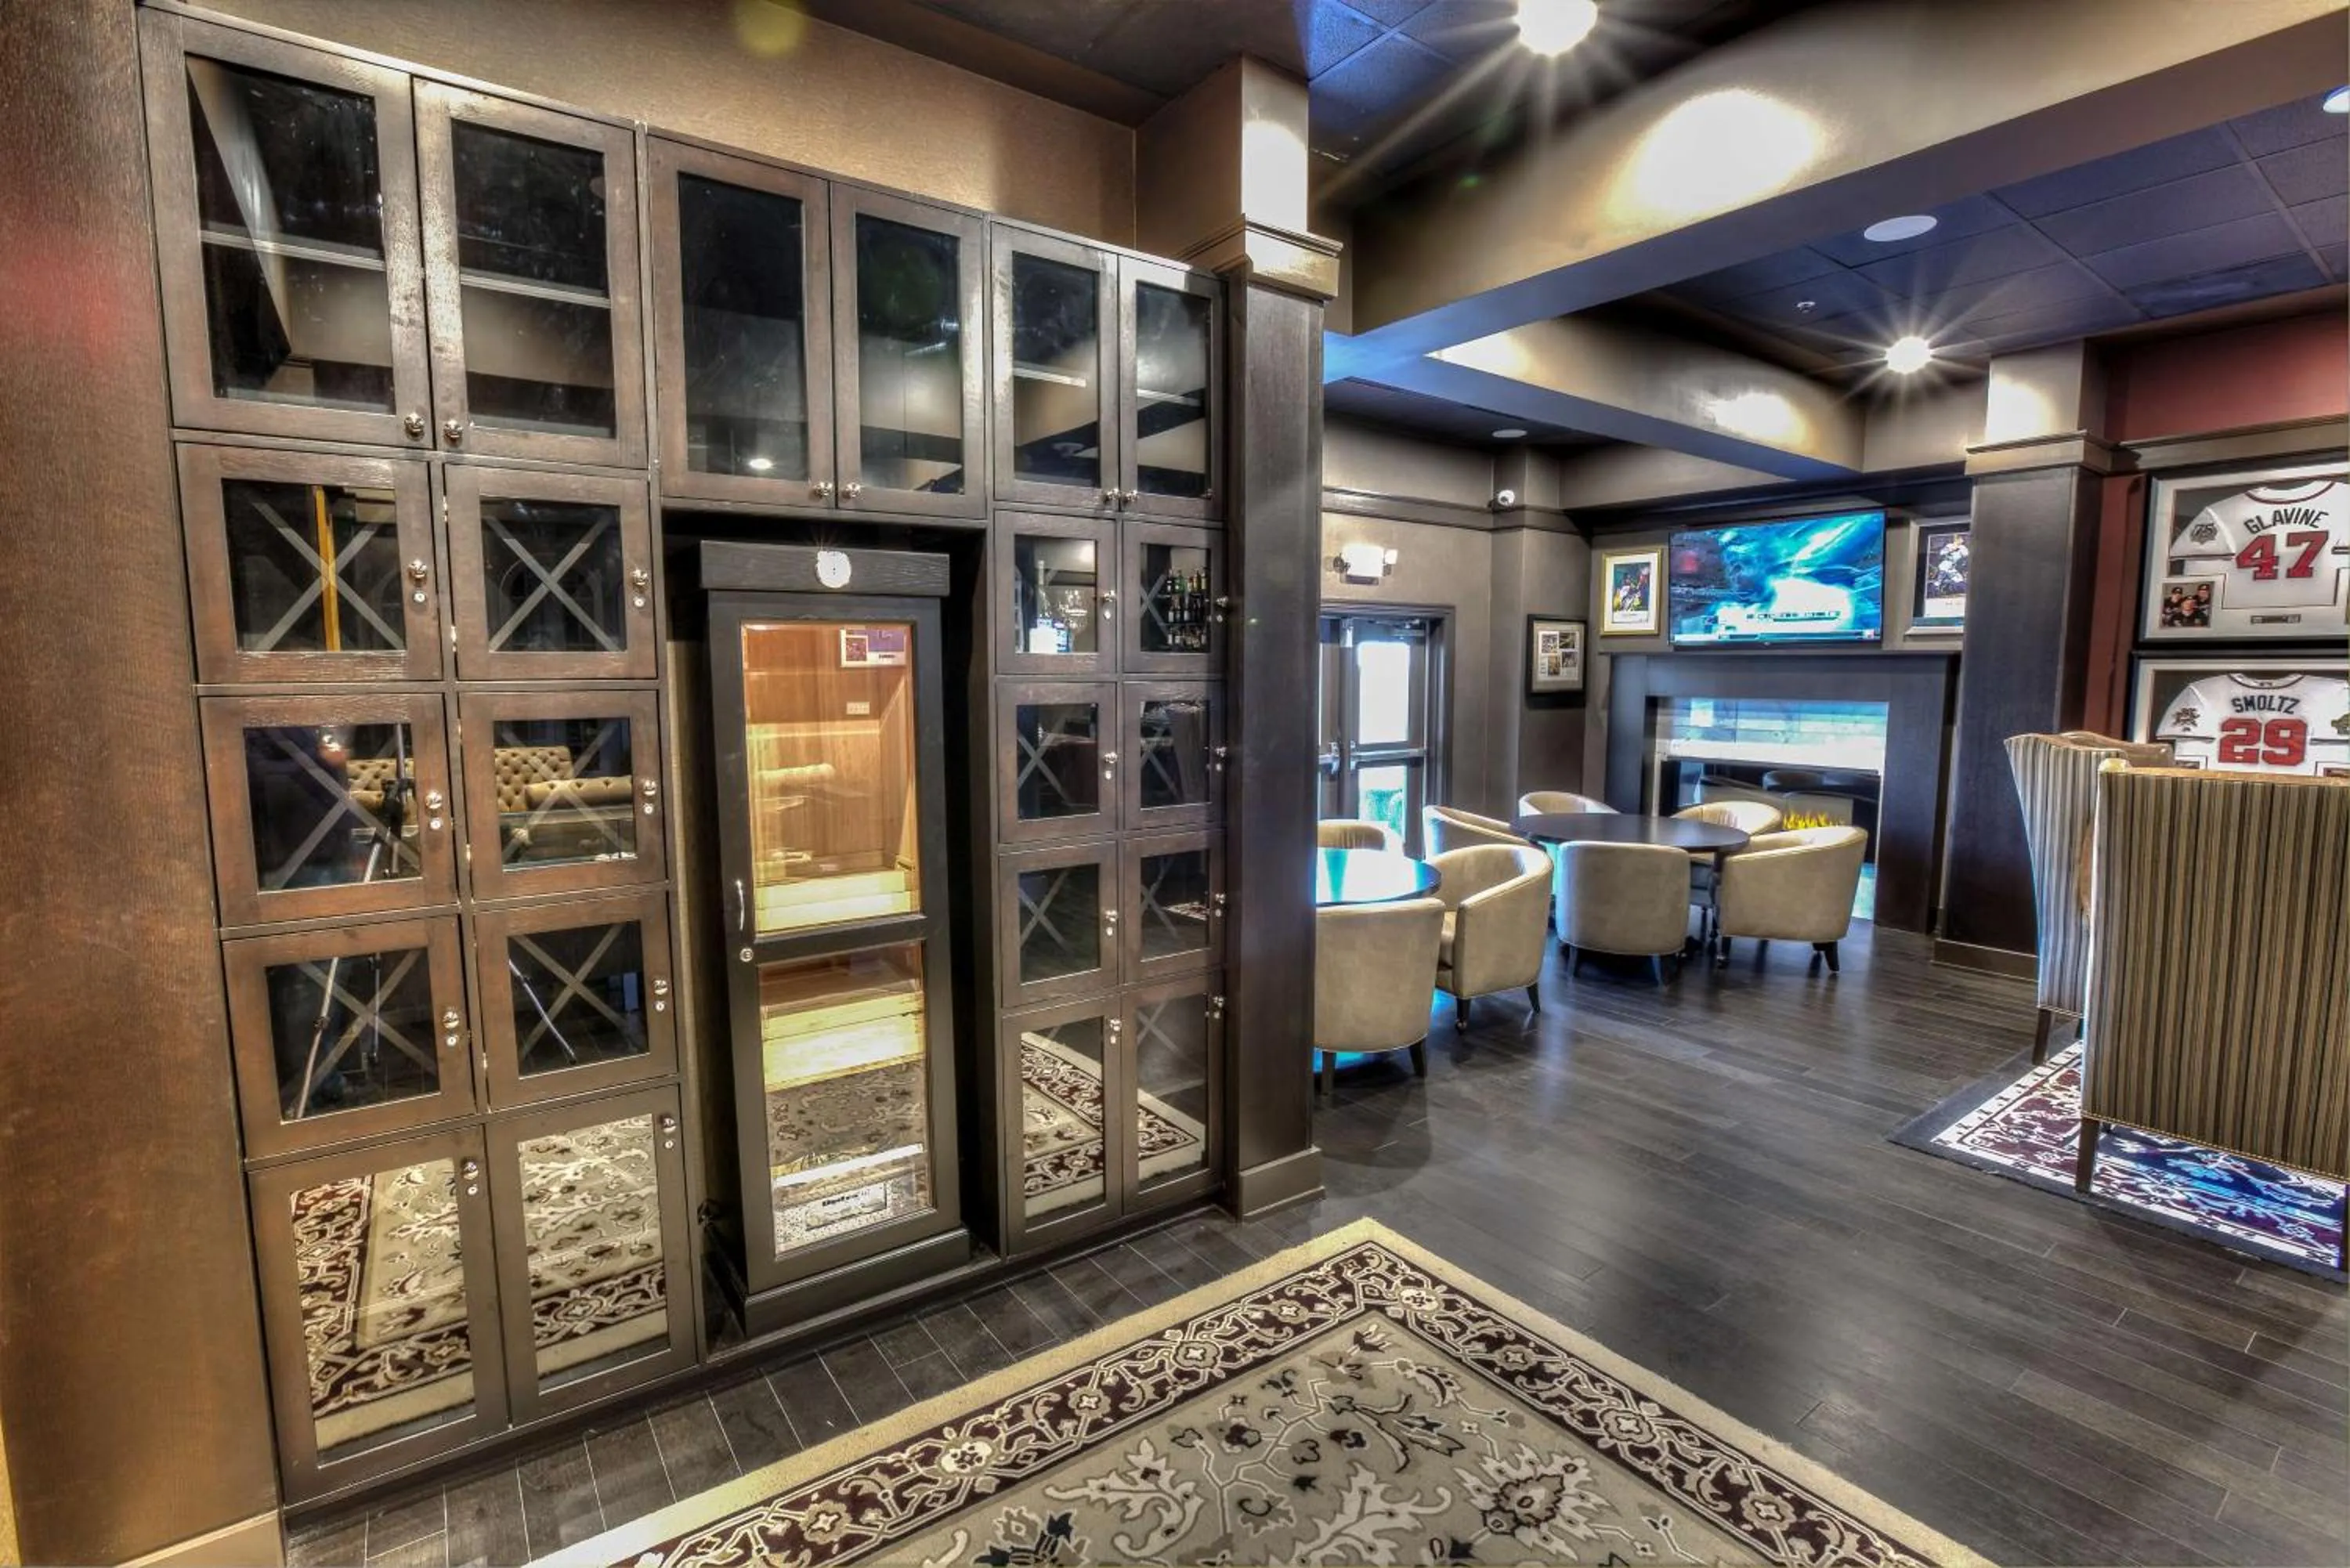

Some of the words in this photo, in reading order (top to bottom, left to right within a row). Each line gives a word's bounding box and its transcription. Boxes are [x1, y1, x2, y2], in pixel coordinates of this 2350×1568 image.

[2243, 508, 2330, 534] GLAVINE
[2236, 530, 2330, 580] 47
[2232, 695, 2300, 714] SMOLTZ
[2218, 717, 2308, 766] 29
